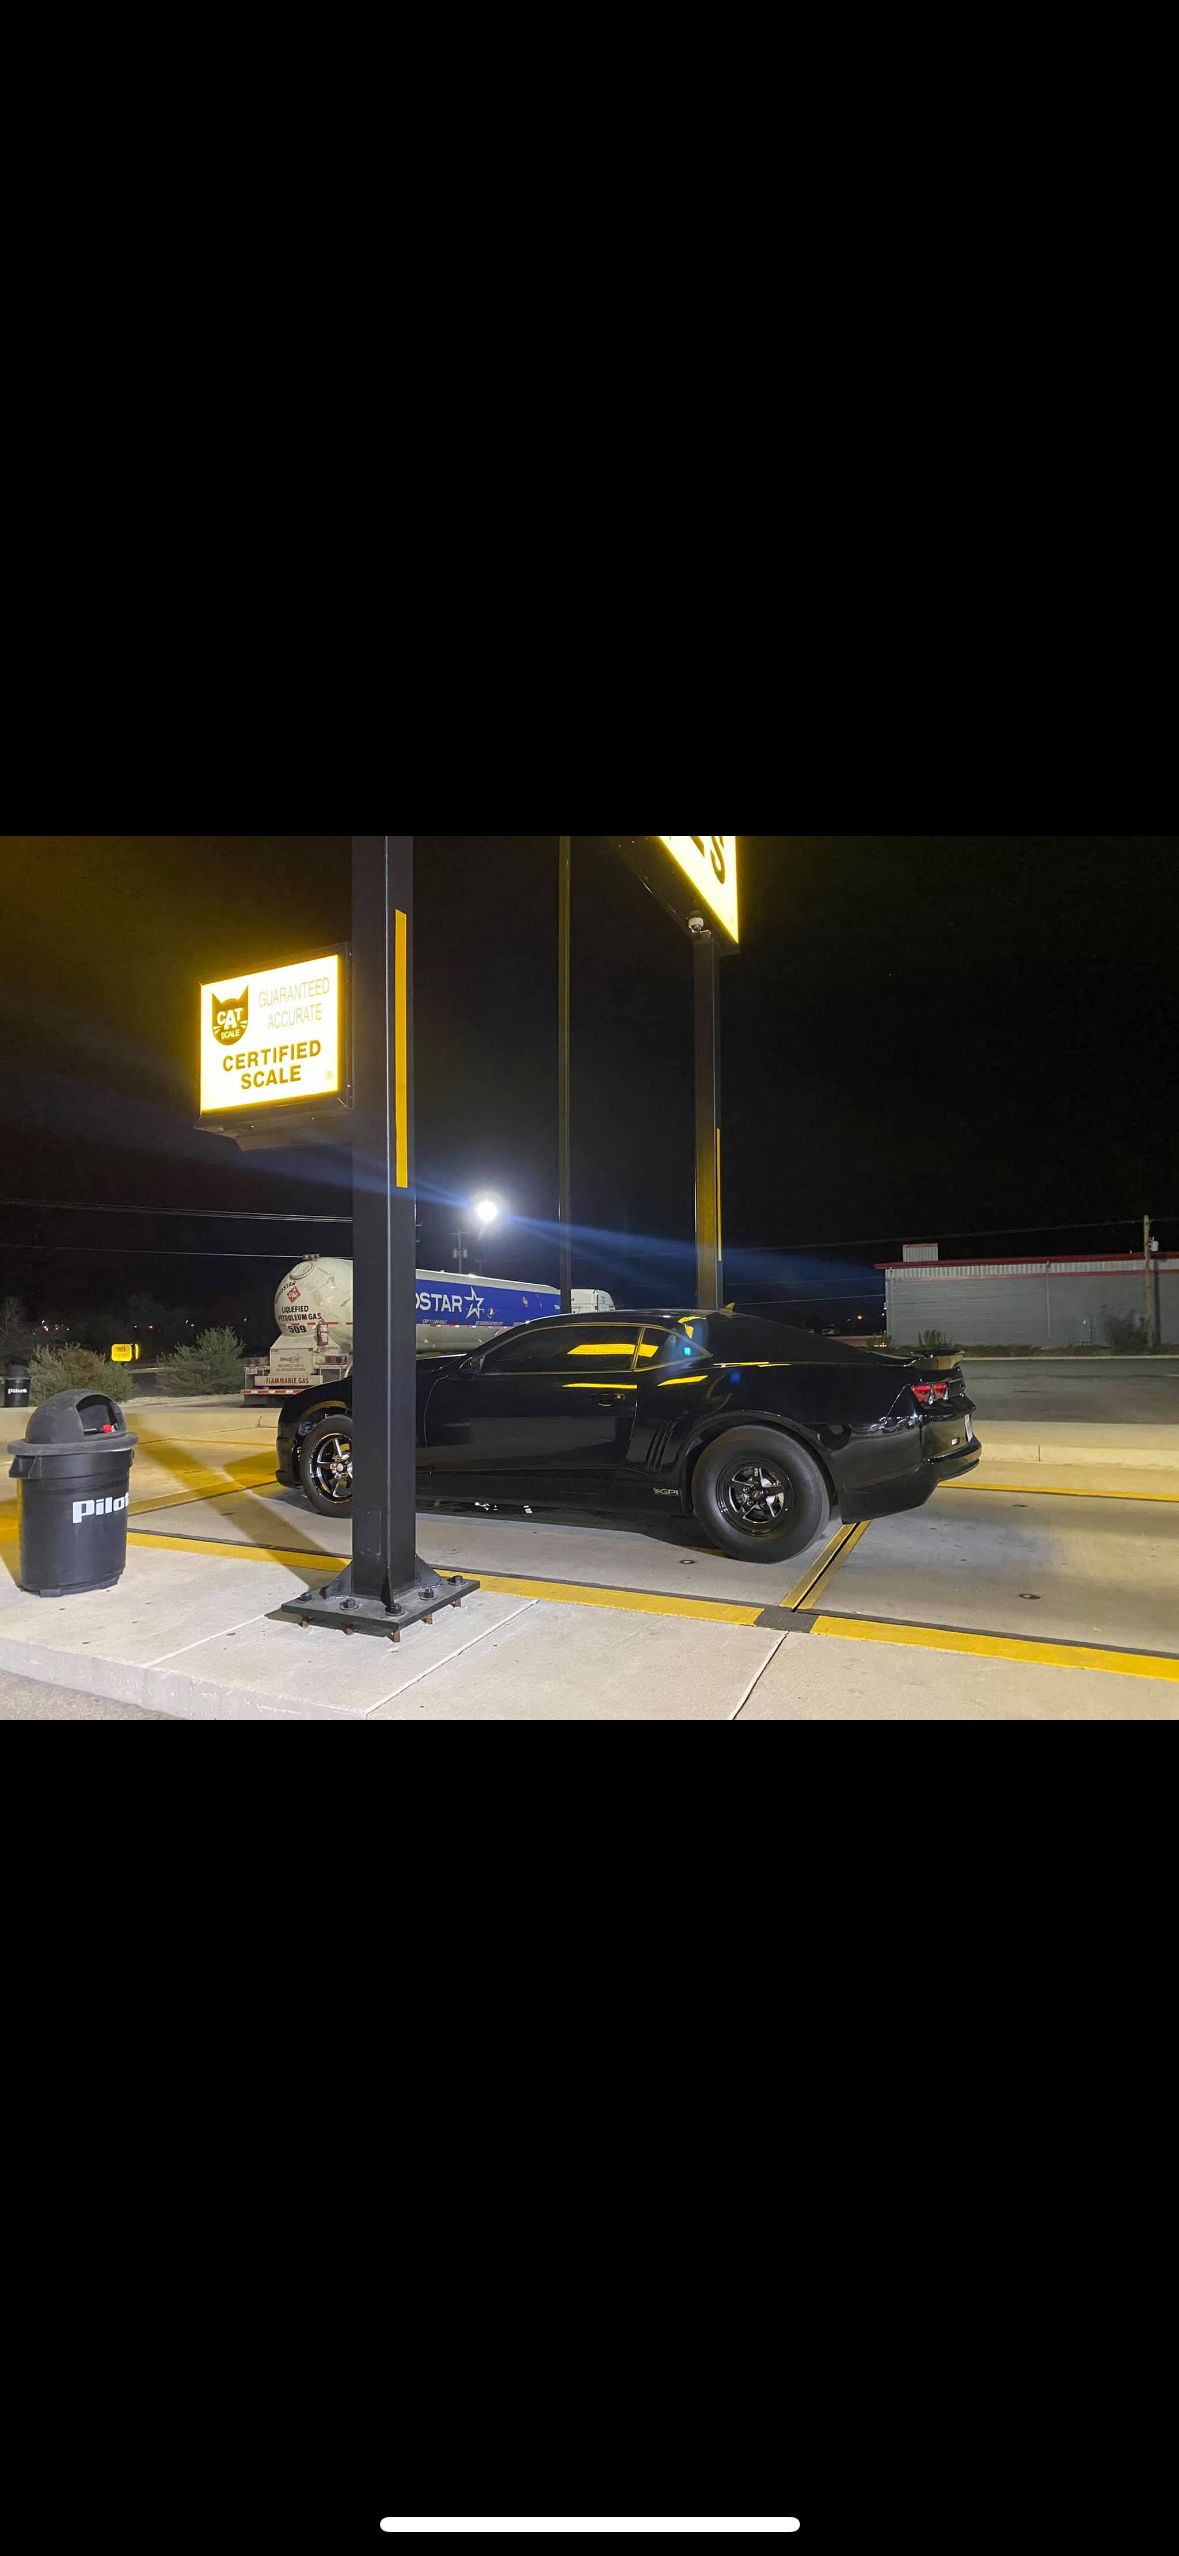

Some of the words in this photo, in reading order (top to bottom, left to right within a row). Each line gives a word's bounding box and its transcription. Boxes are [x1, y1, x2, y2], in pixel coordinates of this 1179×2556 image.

[258, 976, 331, 1008] GUARANTEED
[216, 1007, 244, 1030] CAT
[267, 1003, 323, 1030] ACCURATE
[220, 1029, 241, 1040] SCALE
[222, 1039, 322, 1072] CERTIFIED
[240, 1064, 302, 1090] SCALE
[278, 1313, 308, 1322] PETROLEUM
[307, 1312, 322, 1321] GAS
[281, 1305, 309, 1314] LIQUEFIED
[287, 1325, 307, 1334] 509
[265, 1377, 297, 1385] FLAMMABLE
[298, 1377, 309, 1385] GAS
